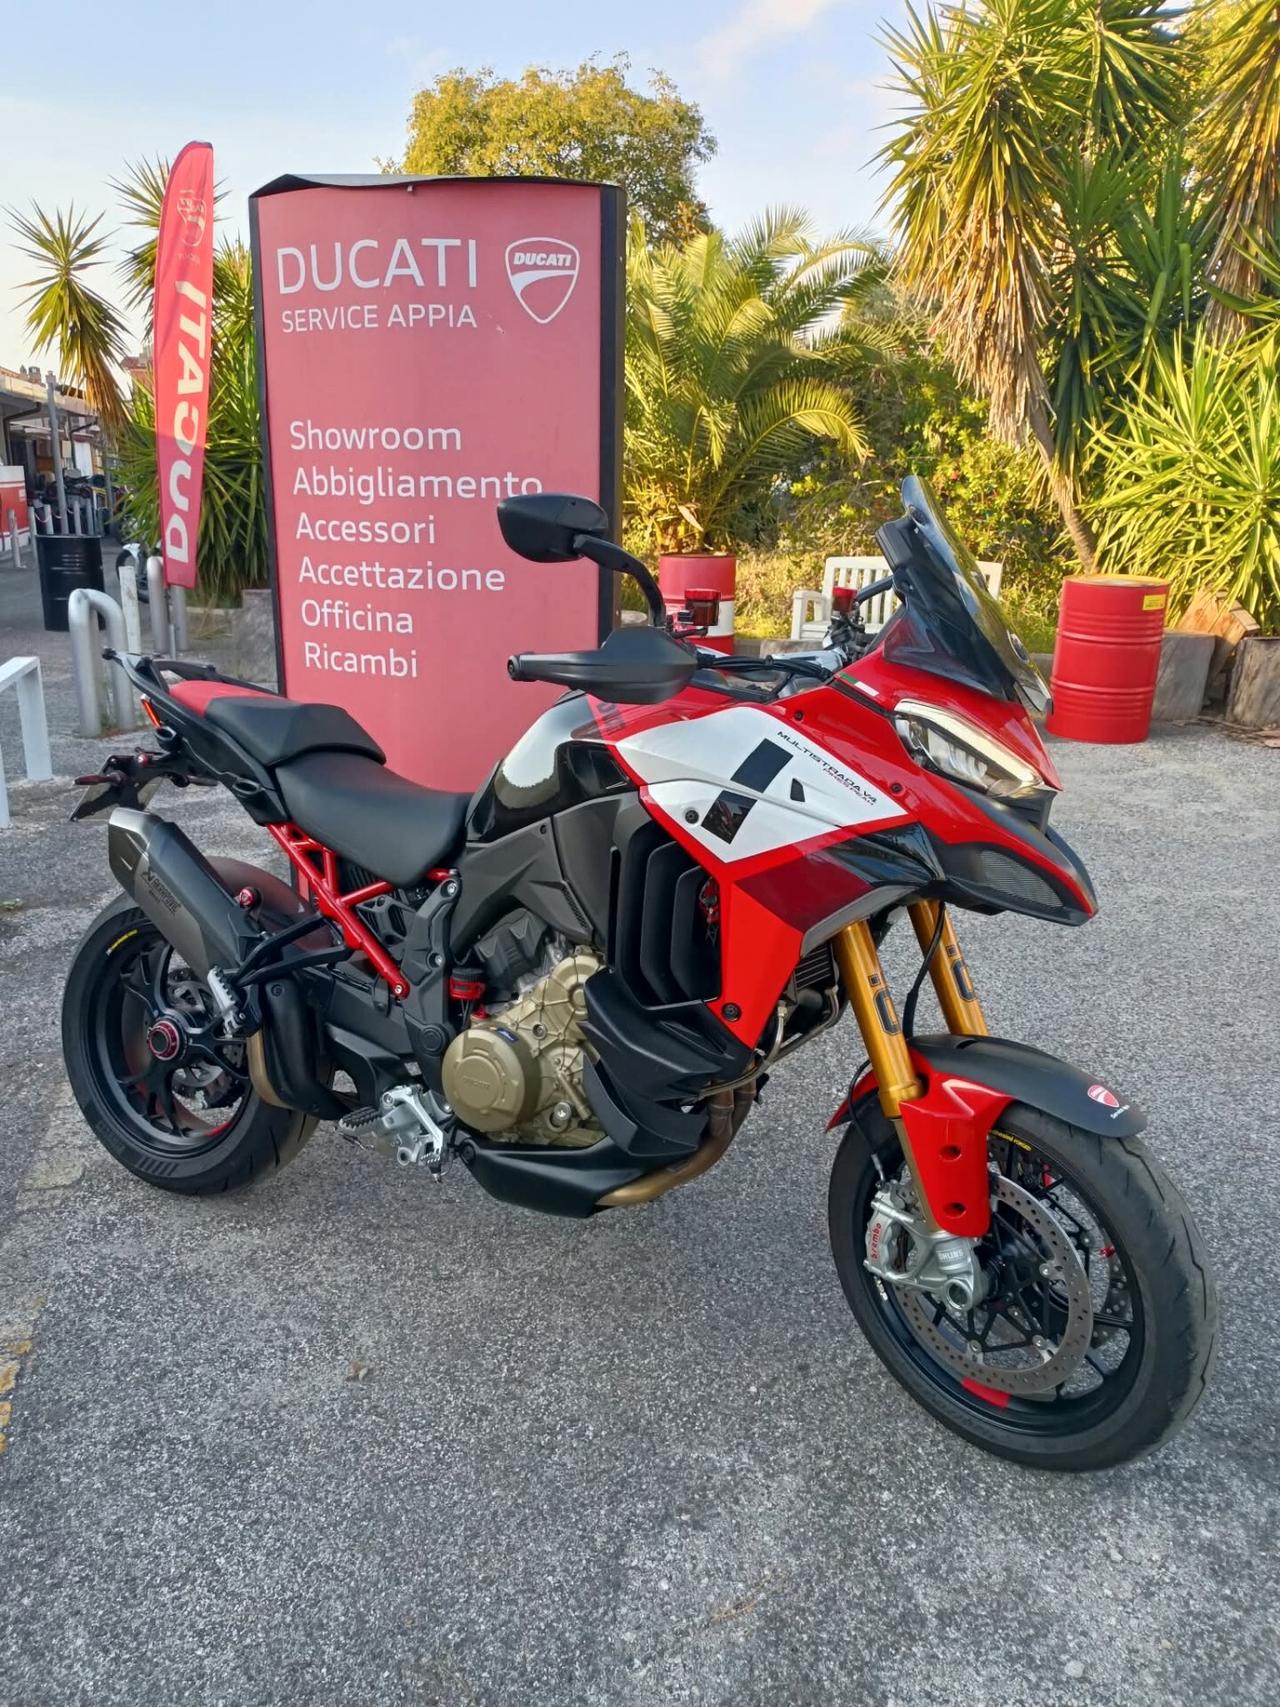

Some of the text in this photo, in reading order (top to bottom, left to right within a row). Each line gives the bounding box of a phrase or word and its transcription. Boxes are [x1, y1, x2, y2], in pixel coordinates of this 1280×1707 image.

[276, 238, 477, 294] DUCATI
[513, 252, 571, 267] DUCATI
[281, 304, 478, 333] SERVICE APPIA
[289, 420, 462, 450] Showroom
[293, 466, 543, 505] Abbigliamento
[296, 512, 436, 544] Accessori
[298, 556, 505, 591] Accettazione
[301, 599, 413, 634] Officina
[304, 641, 417, 678] Ricambi
[777, 731, 877, 803] MULTISTRADA V4
